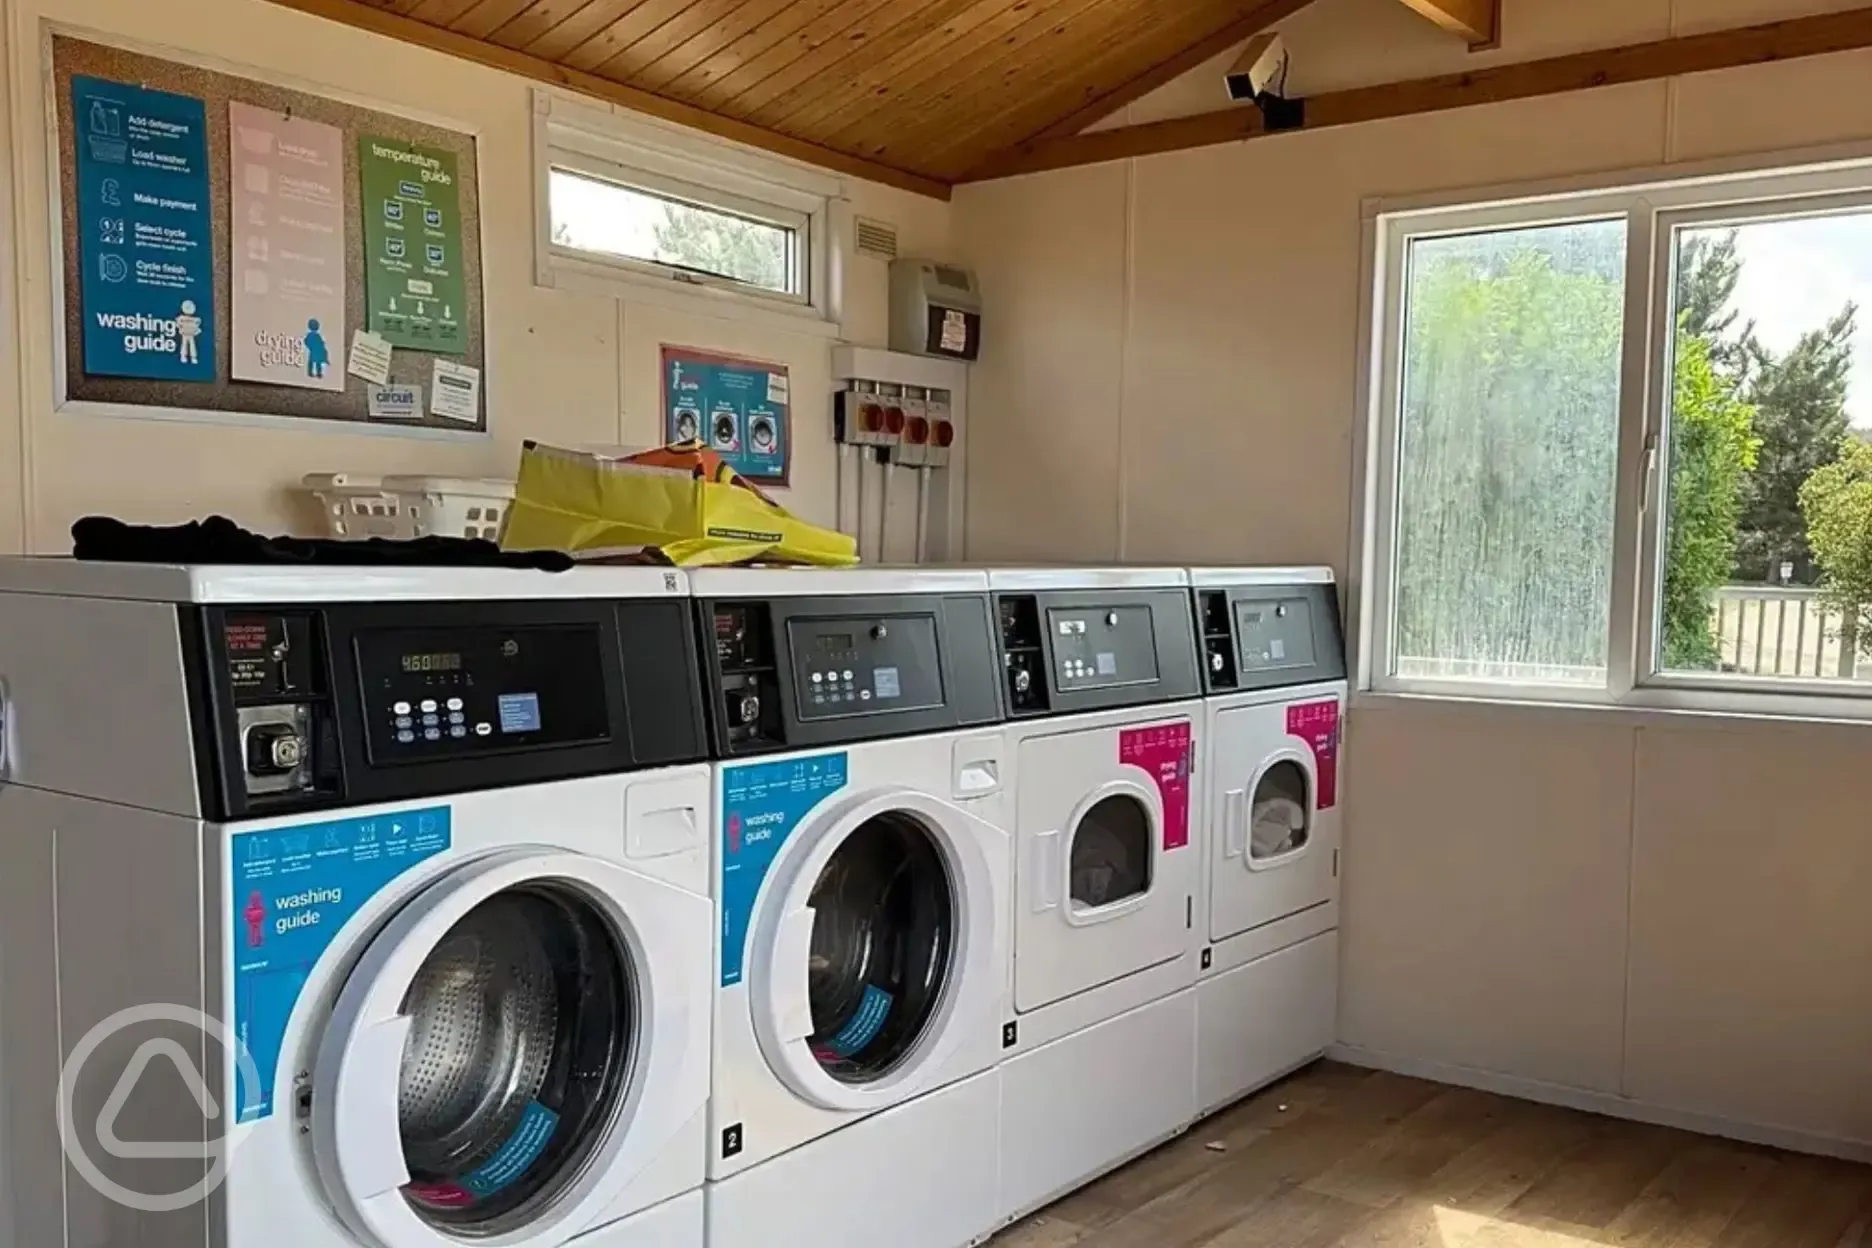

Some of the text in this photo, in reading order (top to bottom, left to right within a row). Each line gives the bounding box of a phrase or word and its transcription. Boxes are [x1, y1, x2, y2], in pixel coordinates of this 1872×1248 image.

[128, 115, 146, 127] Add
[148, 119, 190, 134] detergent
[132, 148, 154, 160] Load
[155, 154, 187, 166] washer
[372, 144, 440, 171] temperature
[421, 168, 452, 186] guide
[133, 192, 197, 212] Make payment
[134, 222, 187, 240] Select cycle
[136, 260, 187, 275] Cycle finish
[97, 312, 177, 337] washing
[124, 334, 176, 353] guide
[255, 329, 304, 352] drying
[260, 349, 305, 368] guide
[376, 389, 414, 404] circuit
[744, 811, 785, 827] washing
[744, 829, 772, 846] guide
[275, 886, 343, 910] washing
[275, 909, 321, 934] guide
[1007, 1027, 1014, 1041] 3
[728, 1132, 738, 1148] 2
